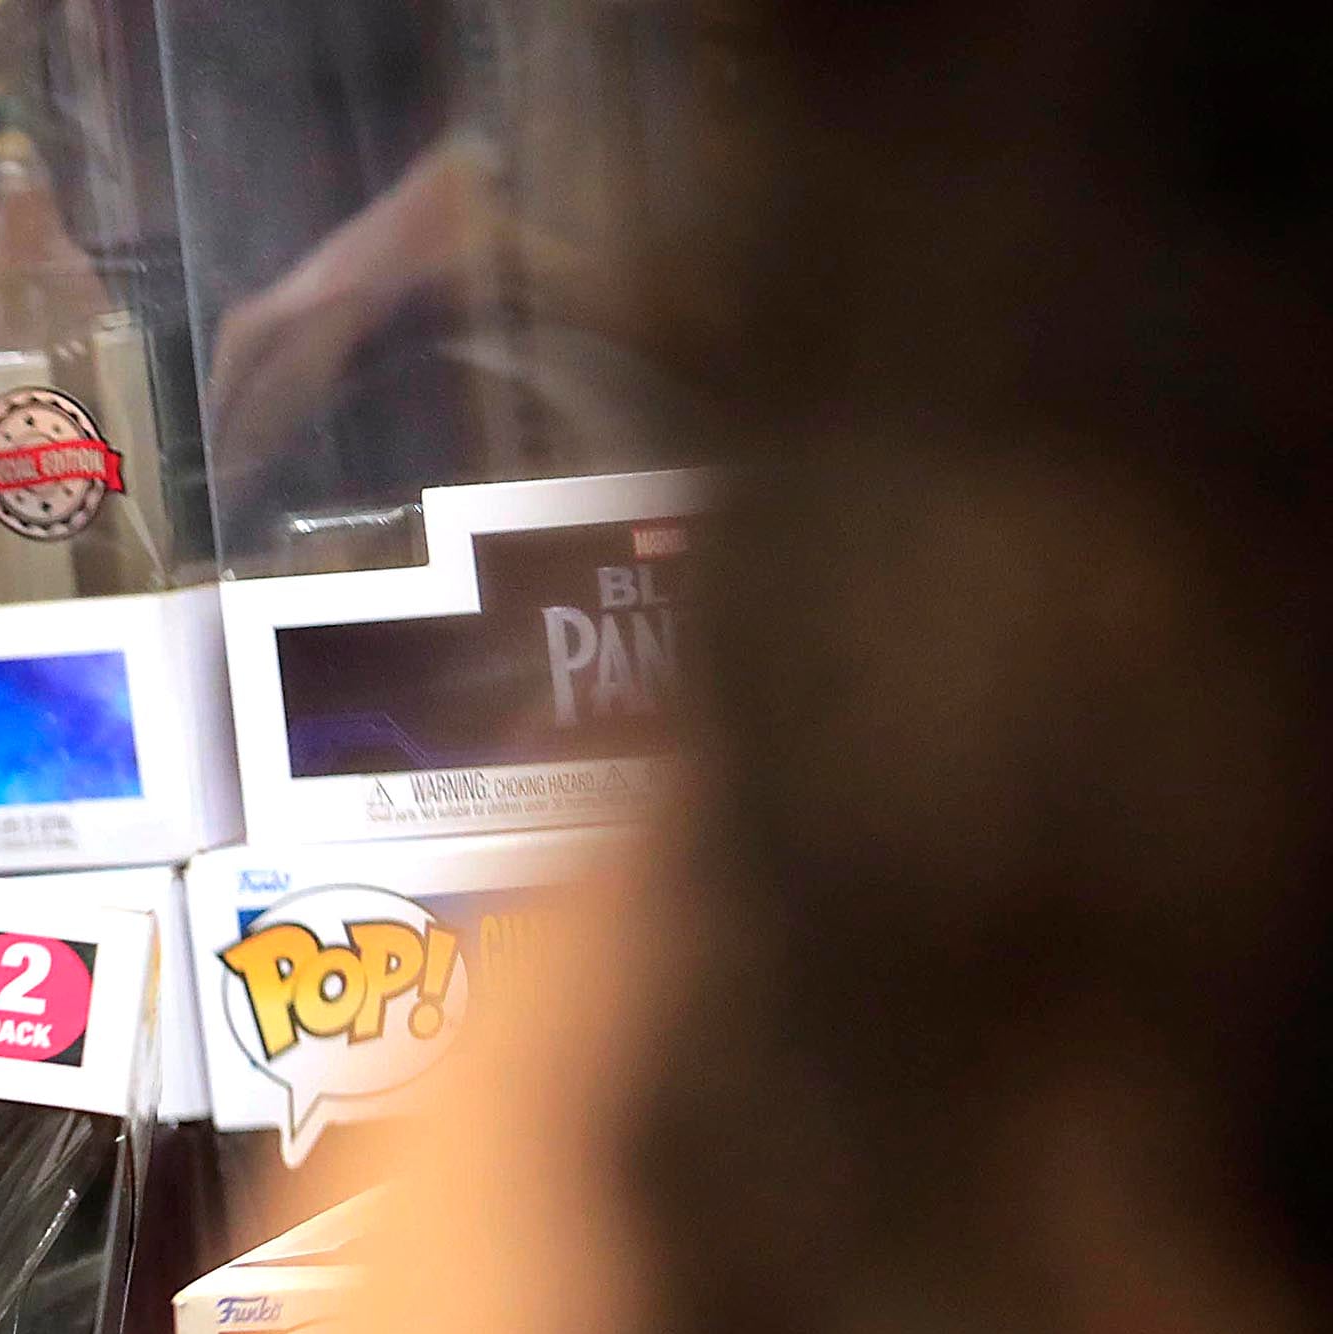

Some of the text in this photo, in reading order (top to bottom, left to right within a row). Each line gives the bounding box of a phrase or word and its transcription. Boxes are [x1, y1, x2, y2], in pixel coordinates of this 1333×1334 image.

[597, 566, 670, 609] BL
[217, 918, 459, 1063] POP!
[216, 1295, 283, 1325] Funko
